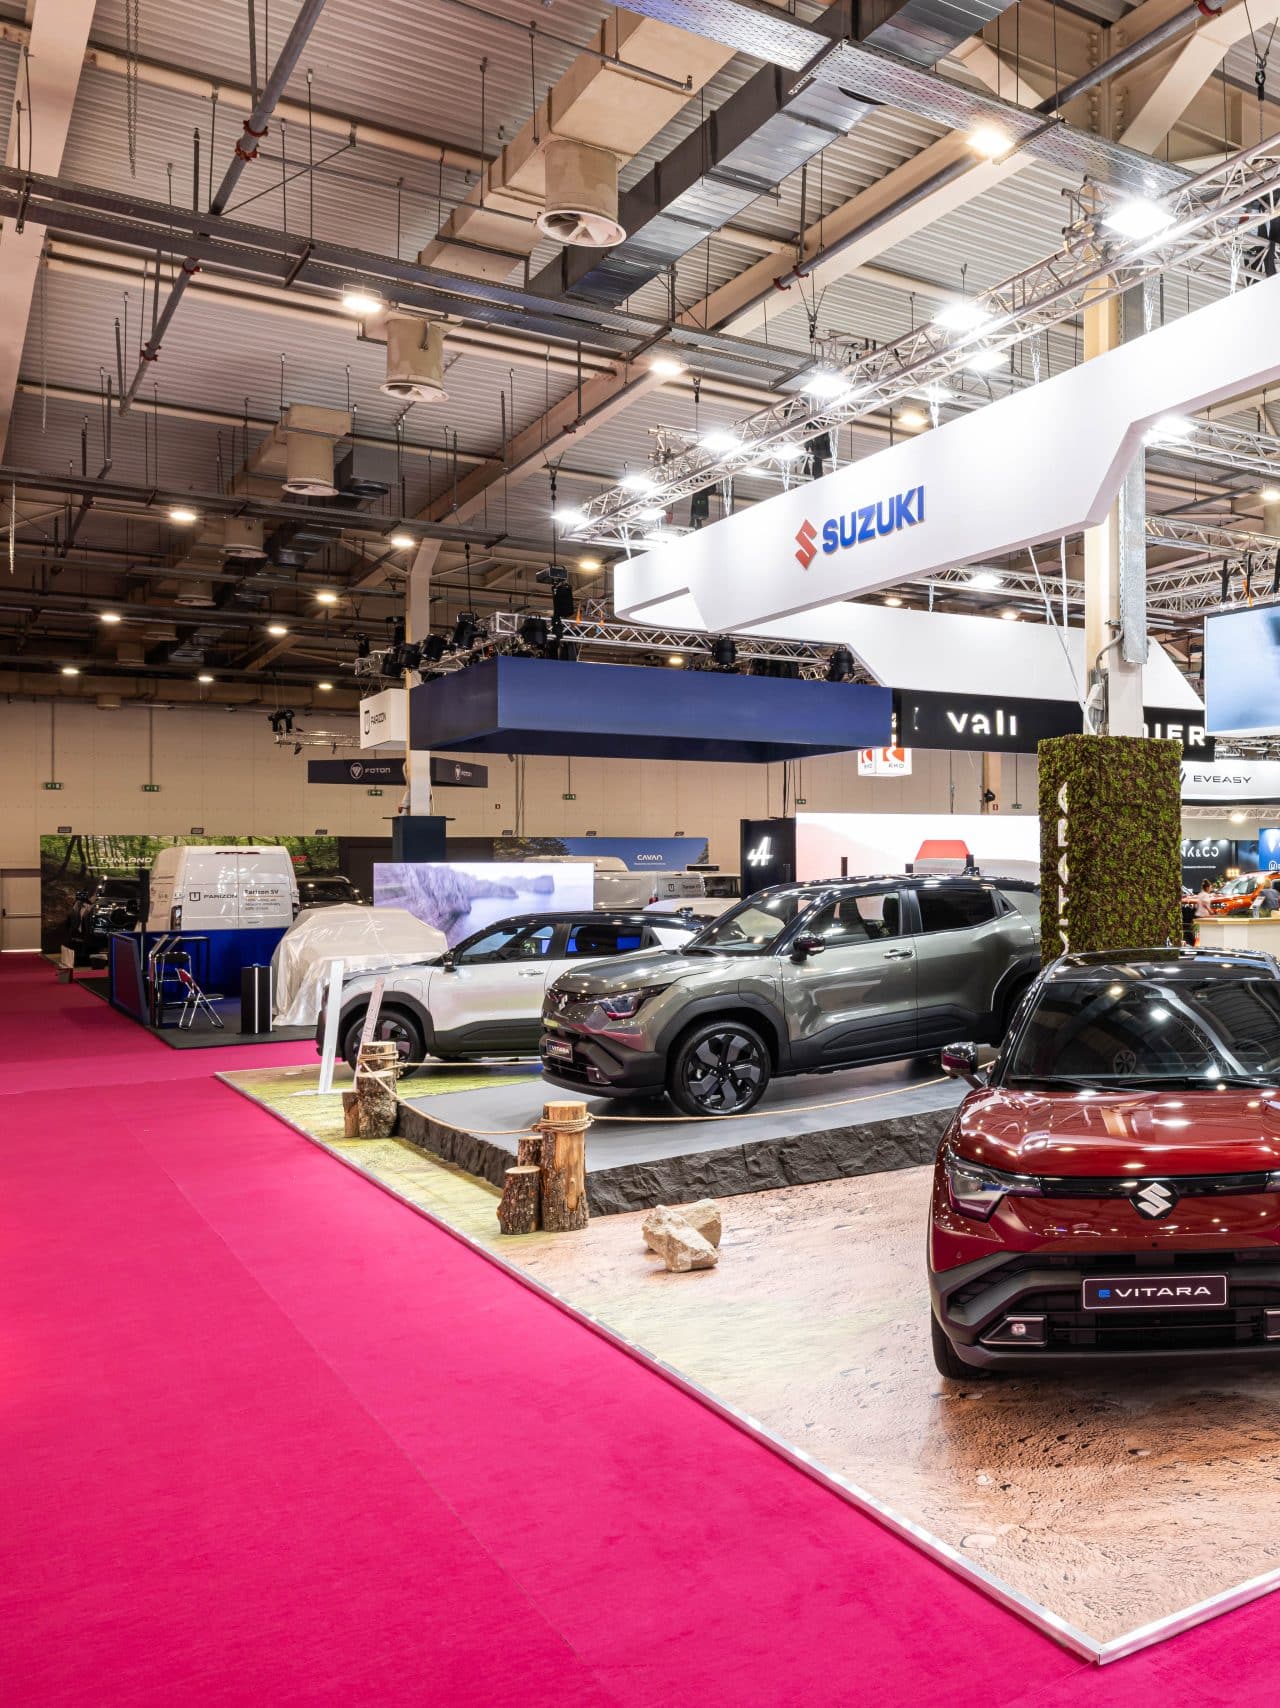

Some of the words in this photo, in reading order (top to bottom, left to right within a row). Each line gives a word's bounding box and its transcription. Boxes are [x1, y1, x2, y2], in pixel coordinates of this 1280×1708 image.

[822, 485, 925, 554] SUZUKI
[1193, 775, 1252, 785] EVEASY
[1115, 1286, 1212, 1297] VITARA
